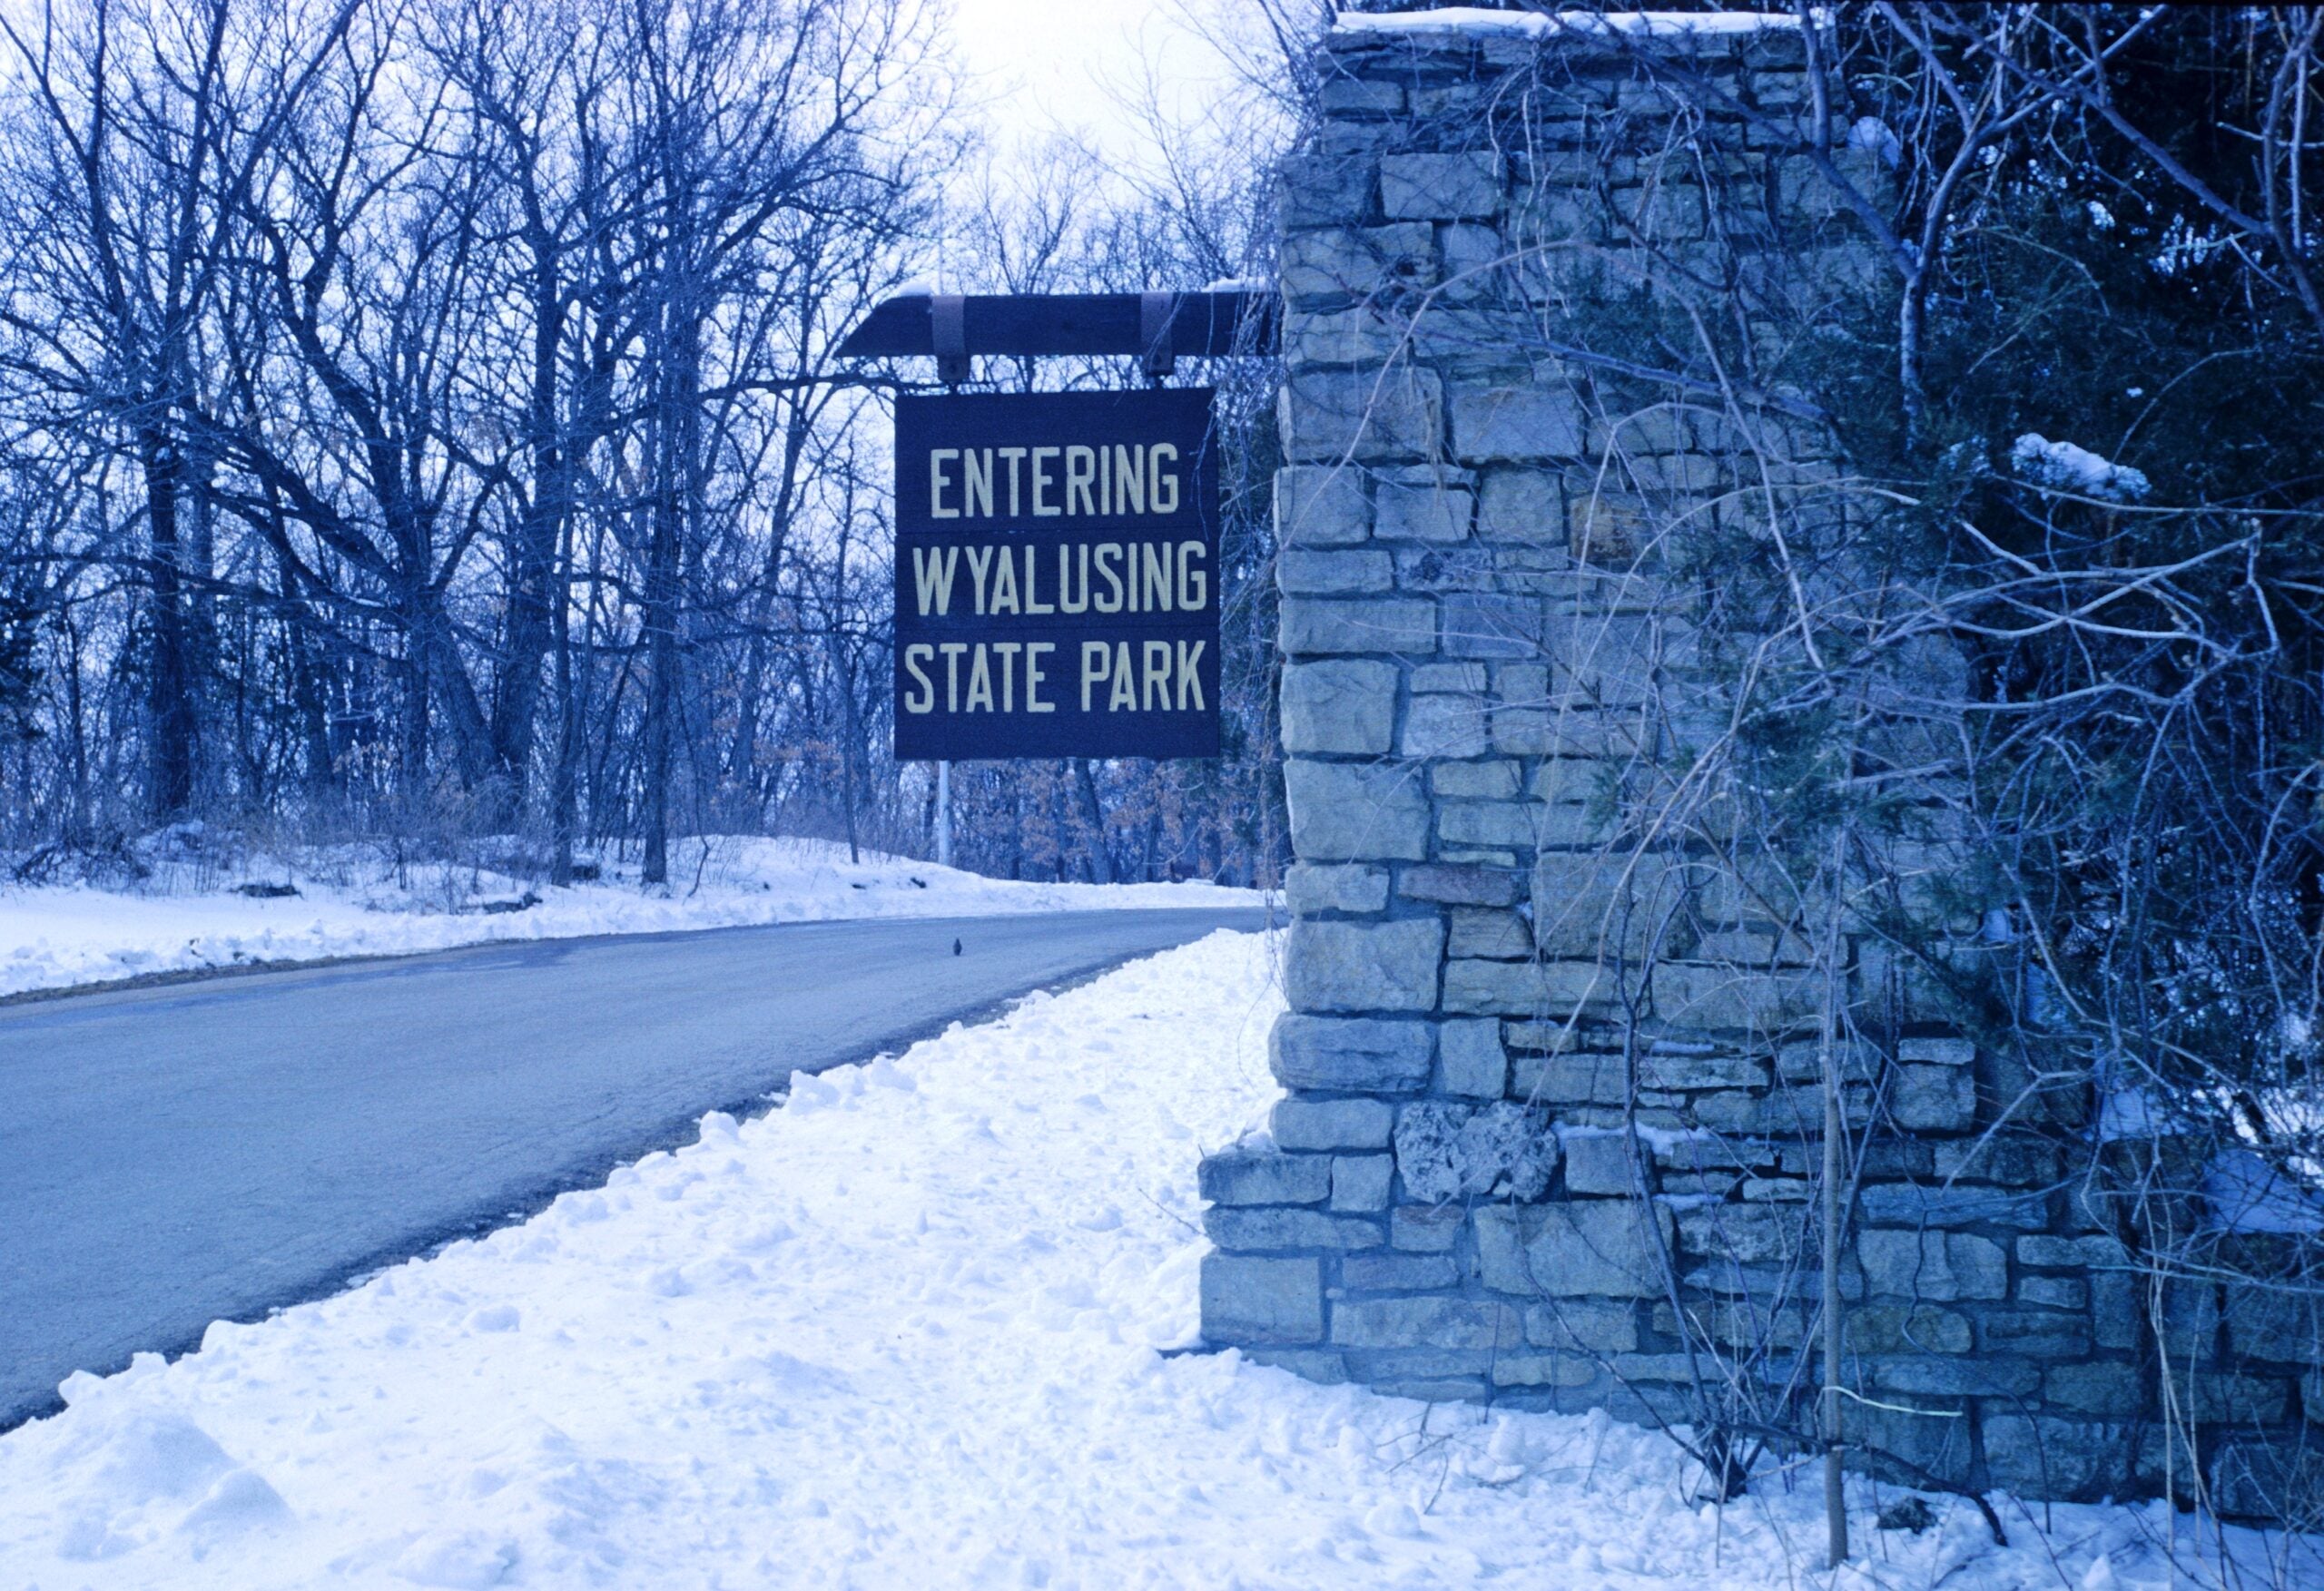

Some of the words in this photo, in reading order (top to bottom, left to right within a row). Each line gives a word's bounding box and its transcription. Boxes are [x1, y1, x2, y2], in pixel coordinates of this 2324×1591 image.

[931, 443, 1178, 518] ENTERING
[913, 540, 1207, 616] WYALUSING
[905, 642, 1056, 714] STATE
[1081, 640, 1206, 712] PARK
